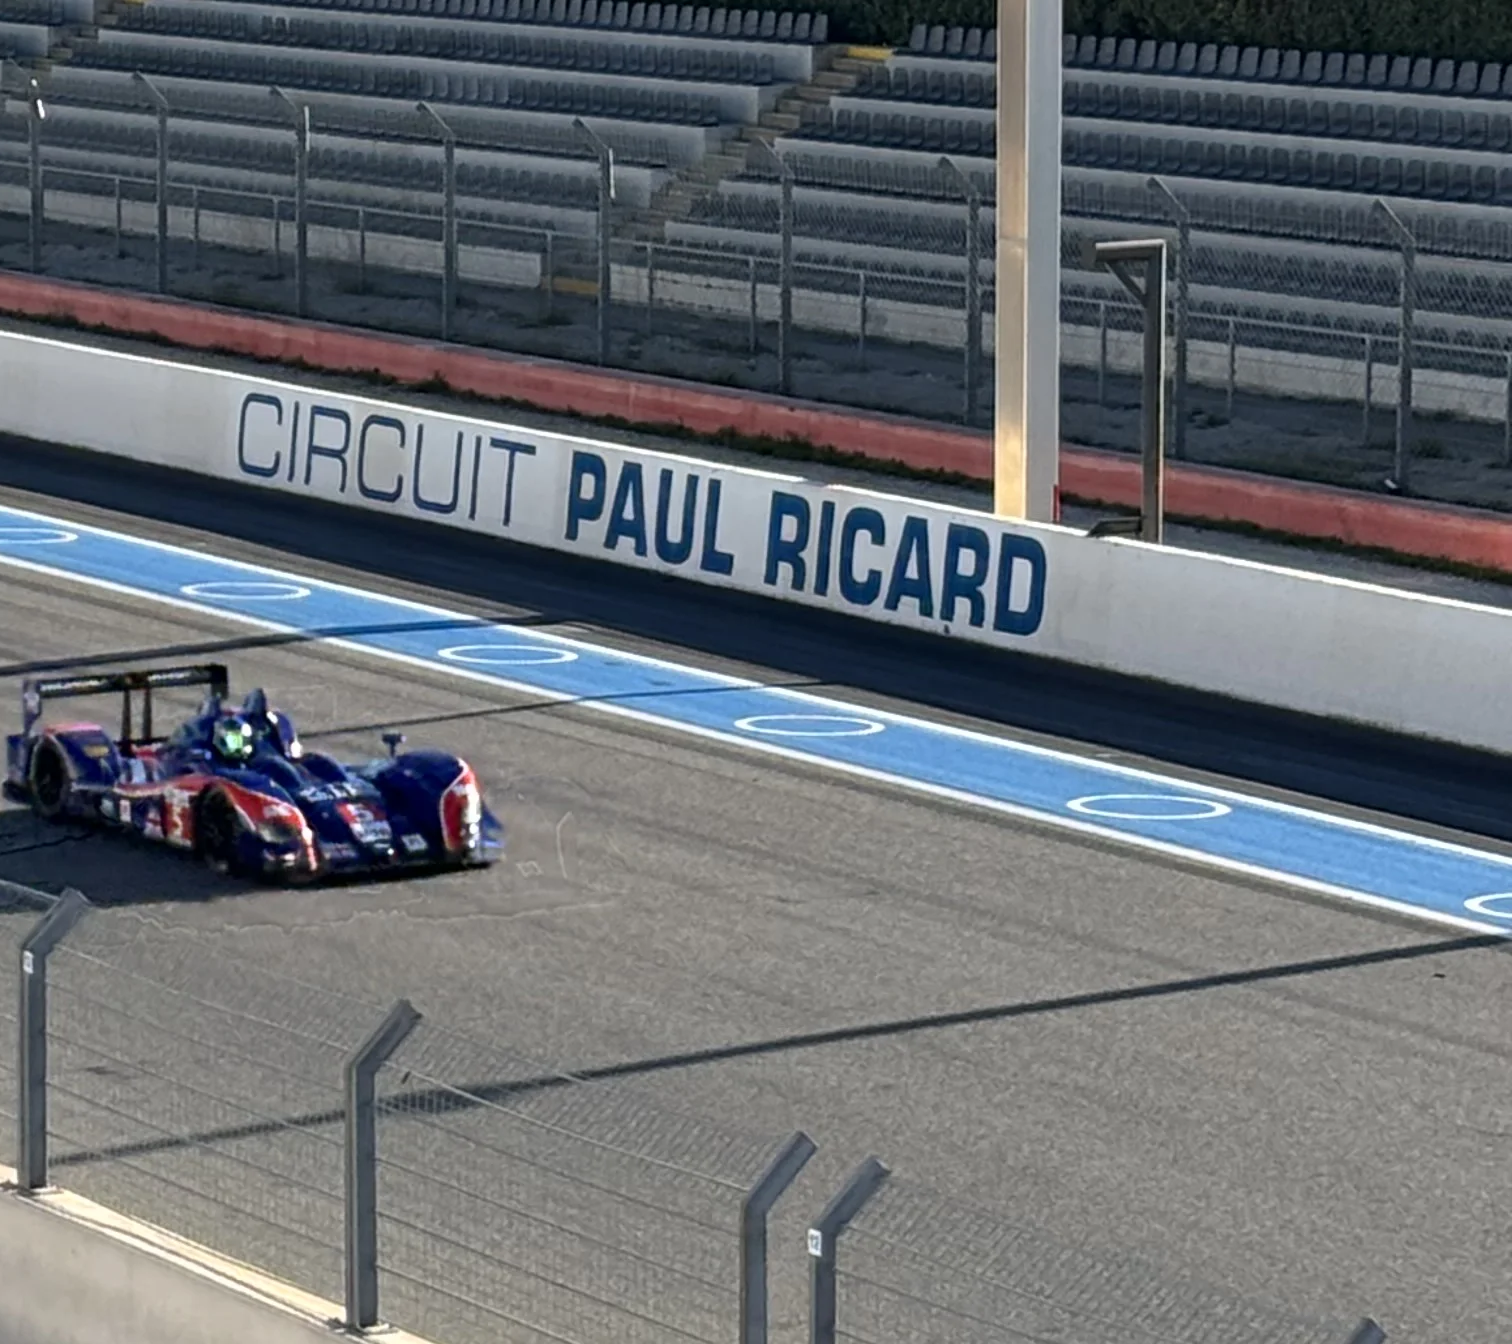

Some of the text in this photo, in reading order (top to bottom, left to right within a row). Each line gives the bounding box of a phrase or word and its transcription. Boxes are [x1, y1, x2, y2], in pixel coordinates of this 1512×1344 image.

[238, 392, 1047, 636] CIRCUIT PAUL RICARD
